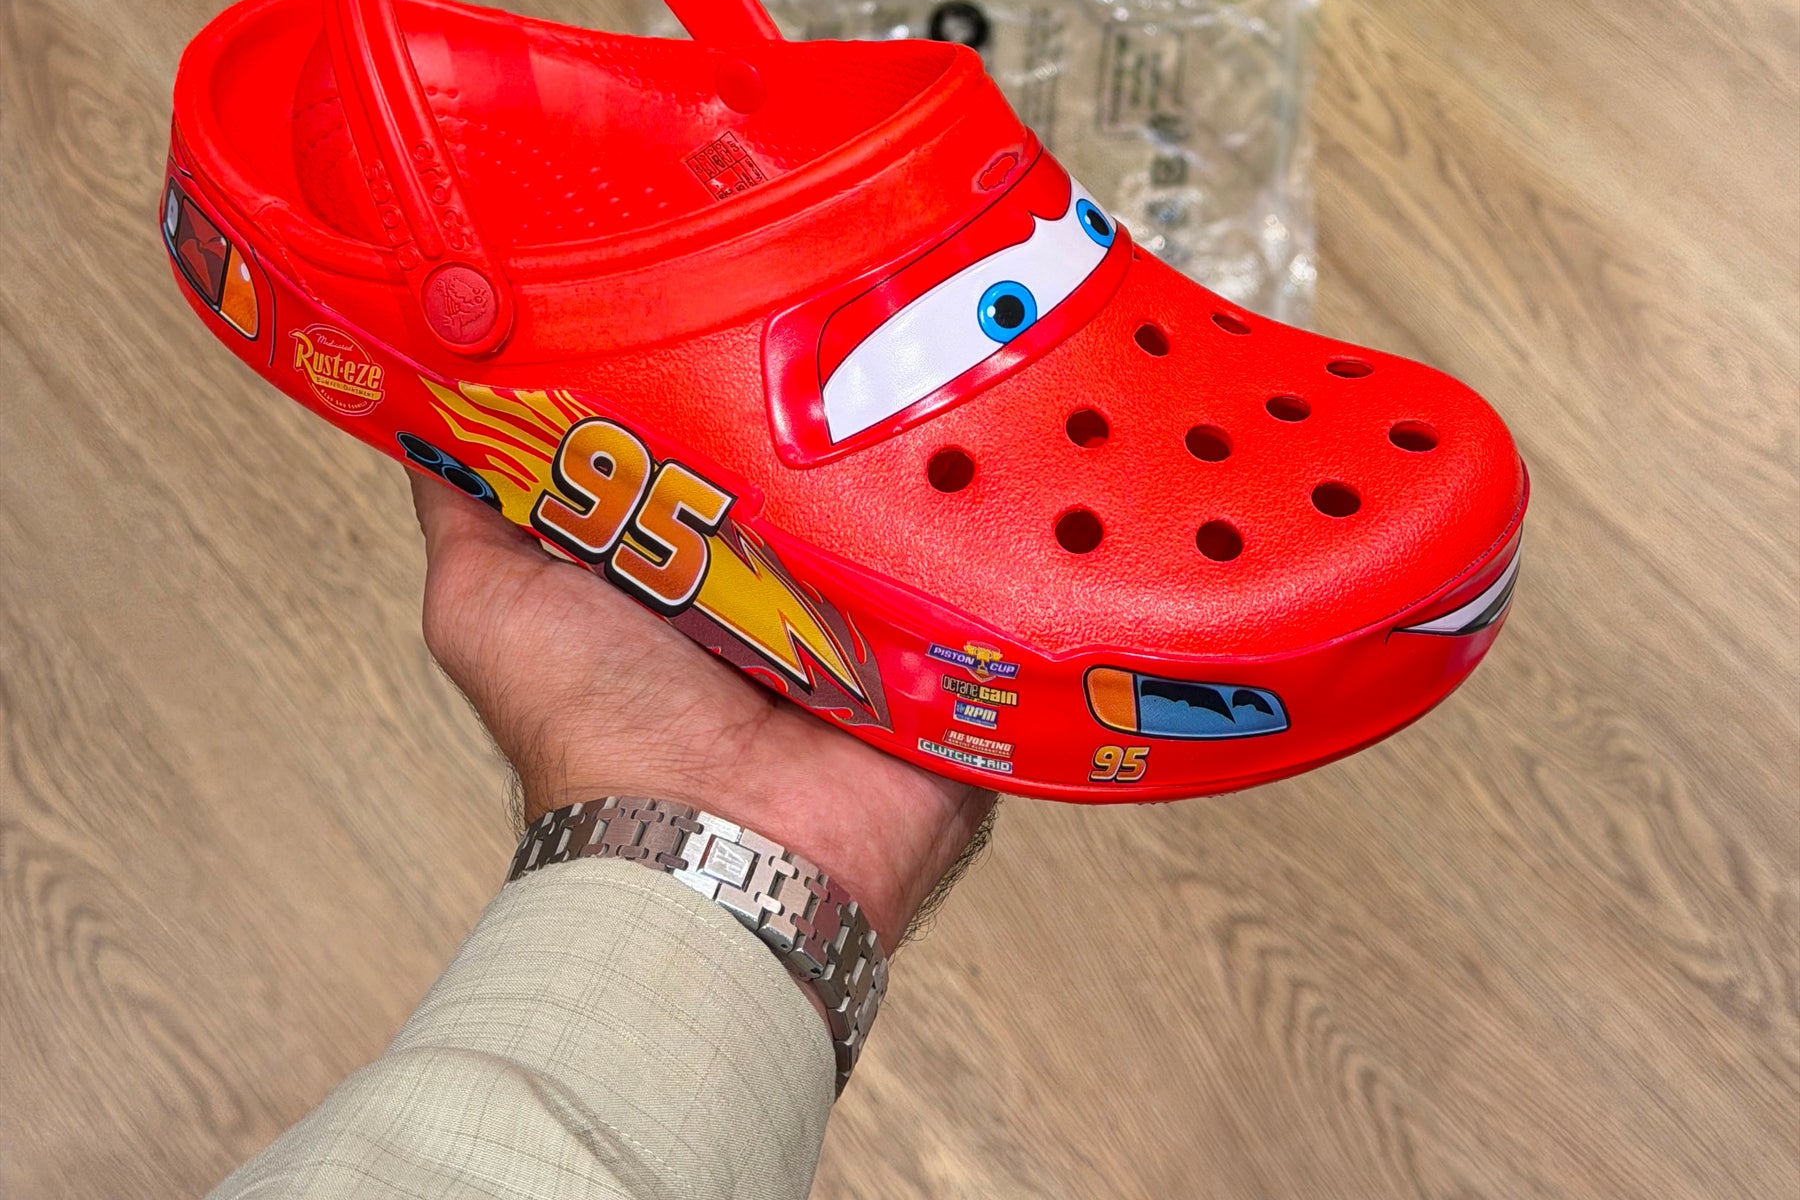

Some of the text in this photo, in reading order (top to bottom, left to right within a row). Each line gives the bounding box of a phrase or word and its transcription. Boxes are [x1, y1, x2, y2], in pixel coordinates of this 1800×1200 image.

[530, 416, 737, 617] 95
[933, 647, 1016, 674] PISTON CUP
[964, 704, 998, 722] RPM
[922, 741, 973, 764] CLUTCH
[1088, 744, 1151, 784] 95
